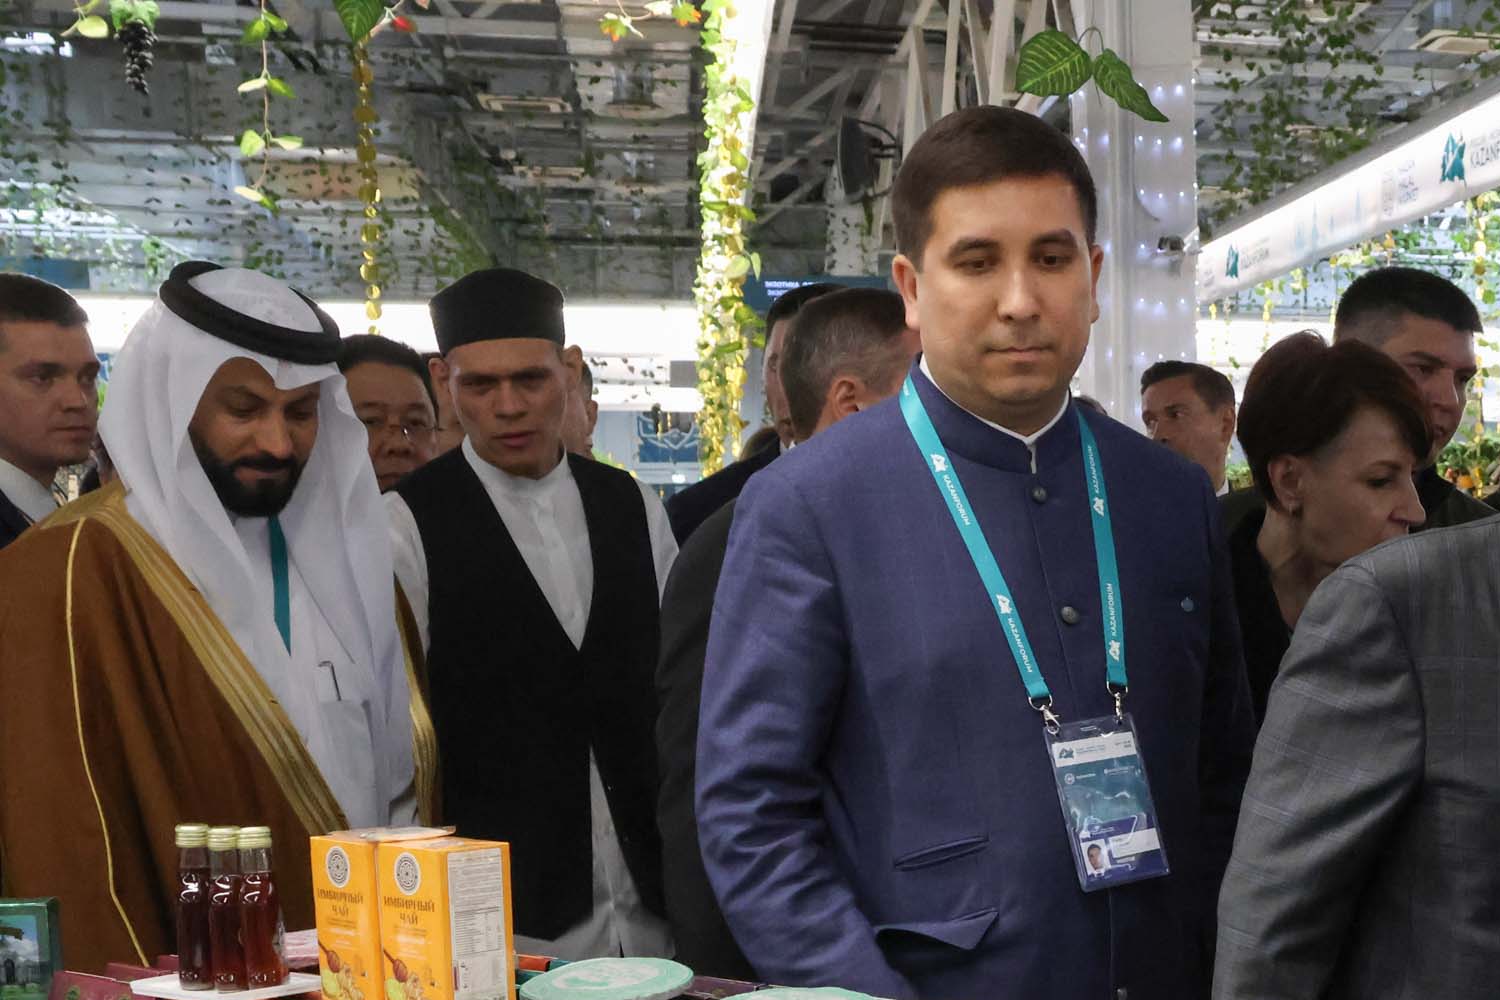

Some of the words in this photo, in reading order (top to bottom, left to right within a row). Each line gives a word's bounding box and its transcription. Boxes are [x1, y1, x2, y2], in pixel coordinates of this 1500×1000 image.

[942, 474, 971, 526] KAZANFORUM
[1006, 616, 1034, 673] KAZANFORUM
[383, 895, 436, 913] ИМБИРНЫЙ
[400, 911, 419, 926] ЧАЙ
